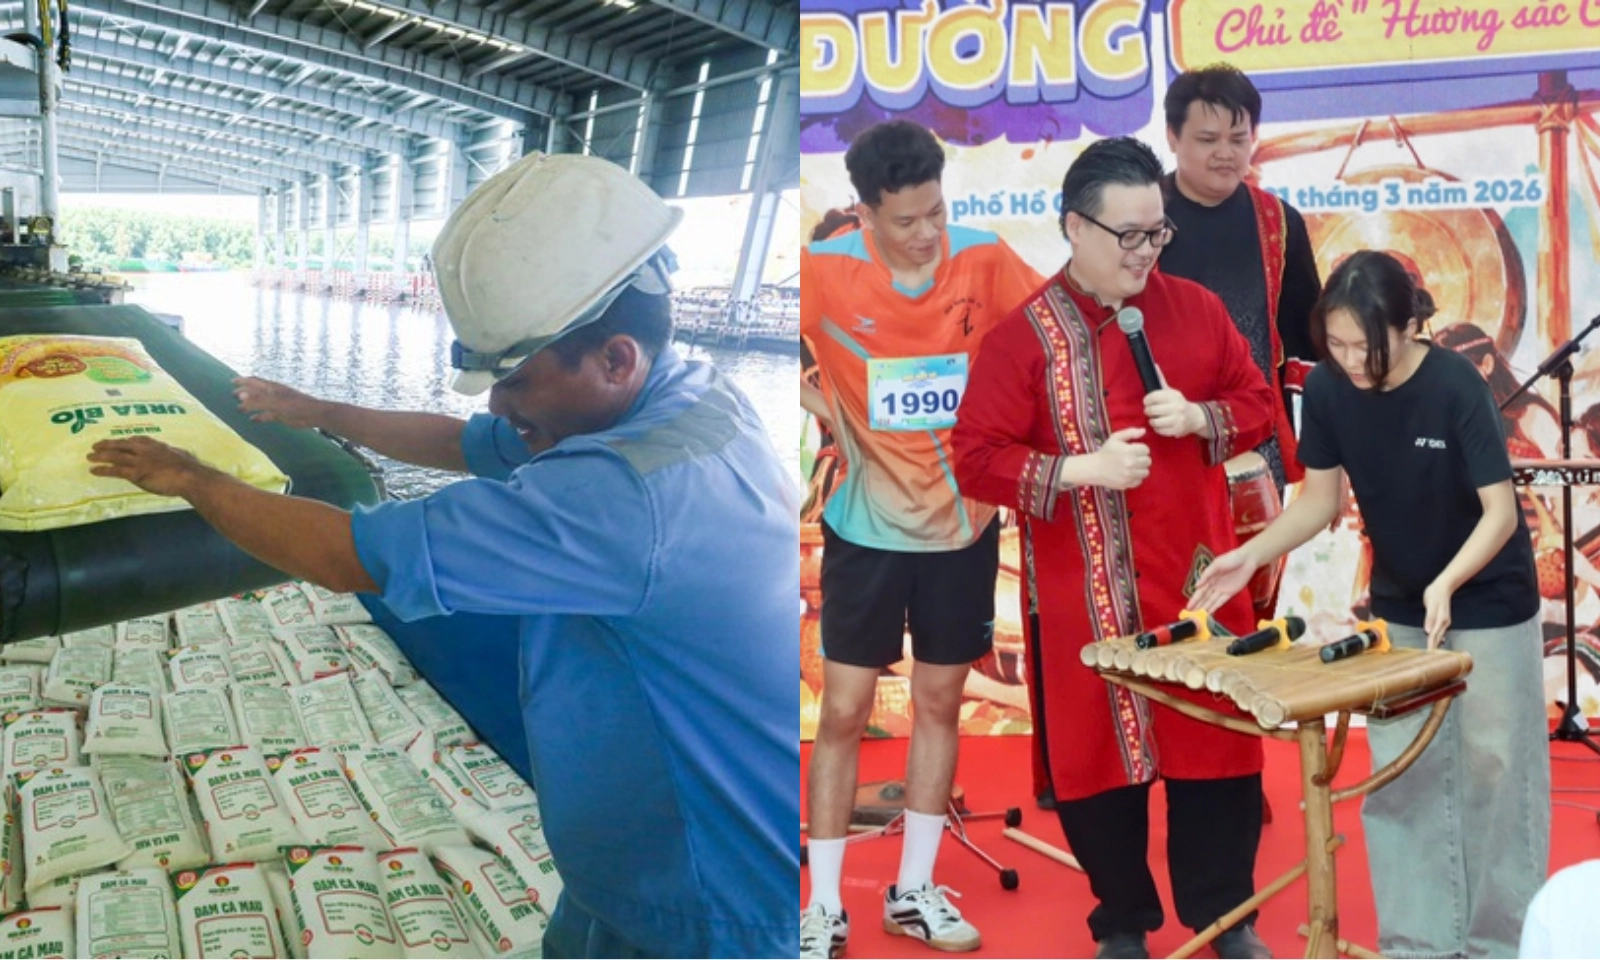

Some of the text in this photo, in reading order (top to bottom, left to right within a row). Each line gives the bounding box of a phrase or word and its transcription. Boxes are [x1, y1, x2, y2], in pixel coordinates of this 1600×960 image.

[1215, 4, 1291, 52] Chủ
[952, 190, 1005, 222] phố
[1010, 189, 1046, 215] Hồ
[1297, 185, 1379, 212] tháng
[1385, 183, 1401, 205] 3
[1408, 183, 1467, 204] năm
[1474, 179, 1542, 203] 2026
[110, 403, 187, 416] UREA
[881, 389, 959, 415] 1990
